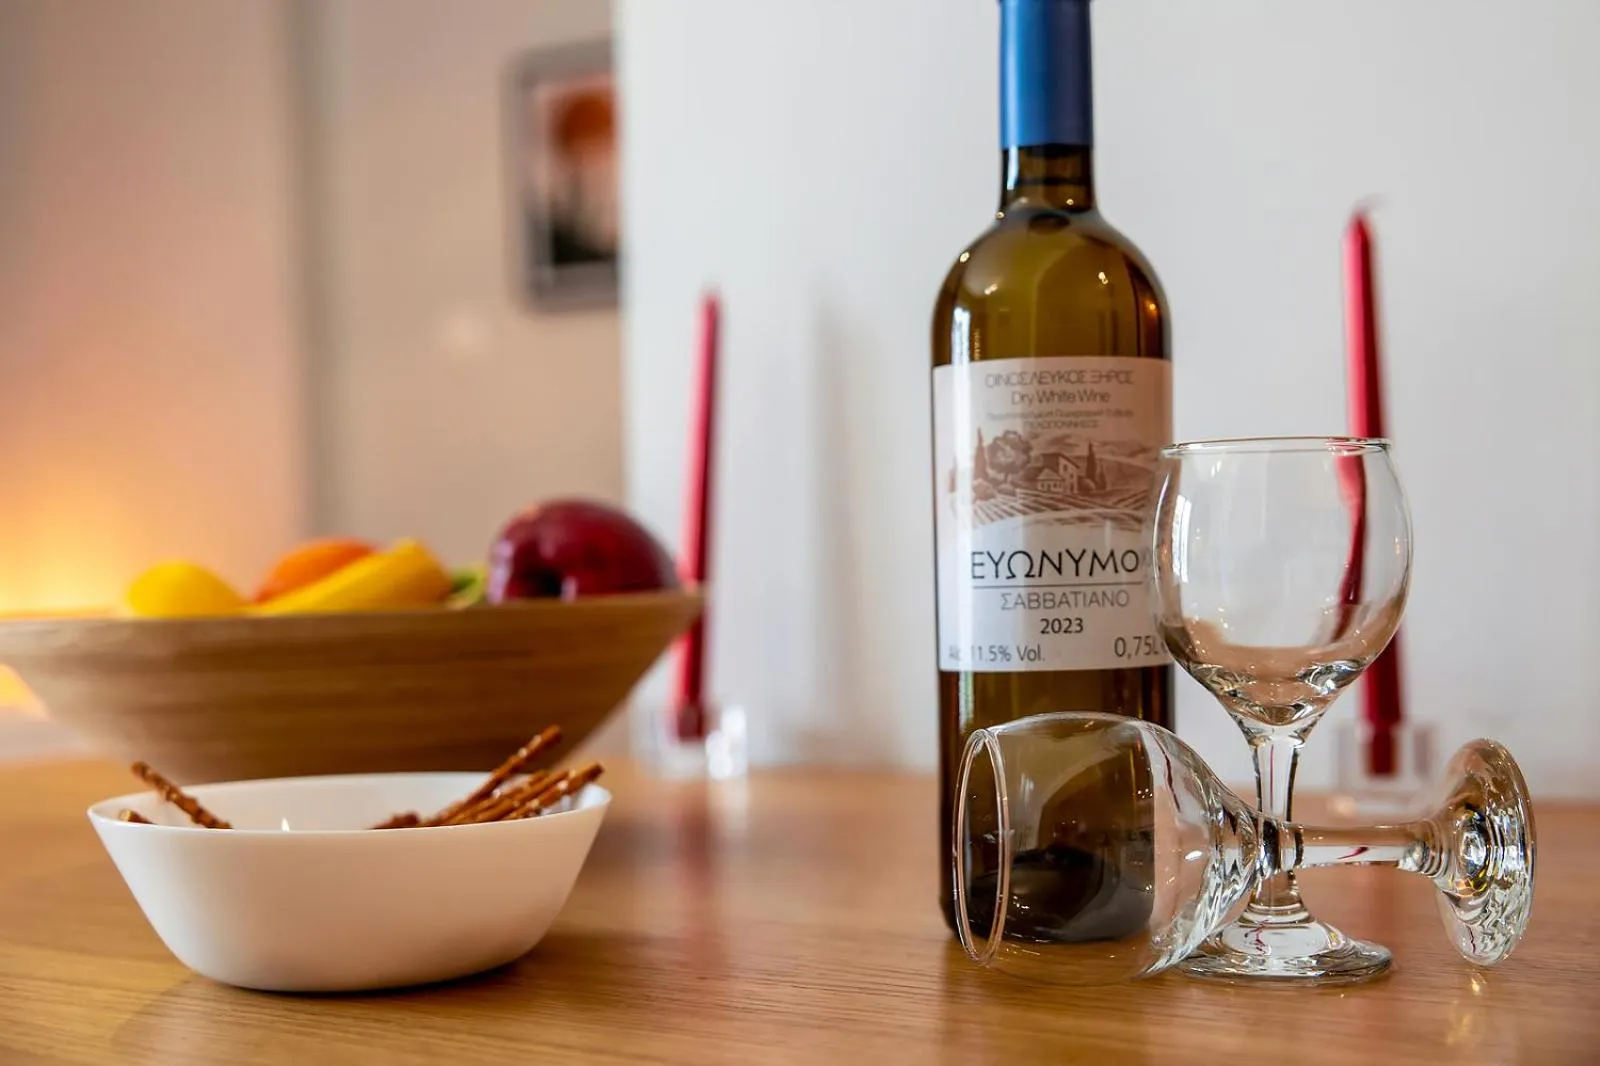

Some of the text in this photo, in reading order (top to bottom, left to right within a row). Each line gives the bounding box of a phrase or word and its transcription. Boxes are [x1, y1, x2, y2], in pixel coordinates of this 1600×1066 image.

[1011, 388, 1111, 406] Dry White Wine
[971, 548, 1150, 580] ΕΥΩΝΥΜΟ
[1000, 589, 1130, 611] ΣΑΒΒΑΤΙΑΝΟ
[1040, 617, 1084, 634] 2023
[1016, 643, 1046, 662] Vol.
